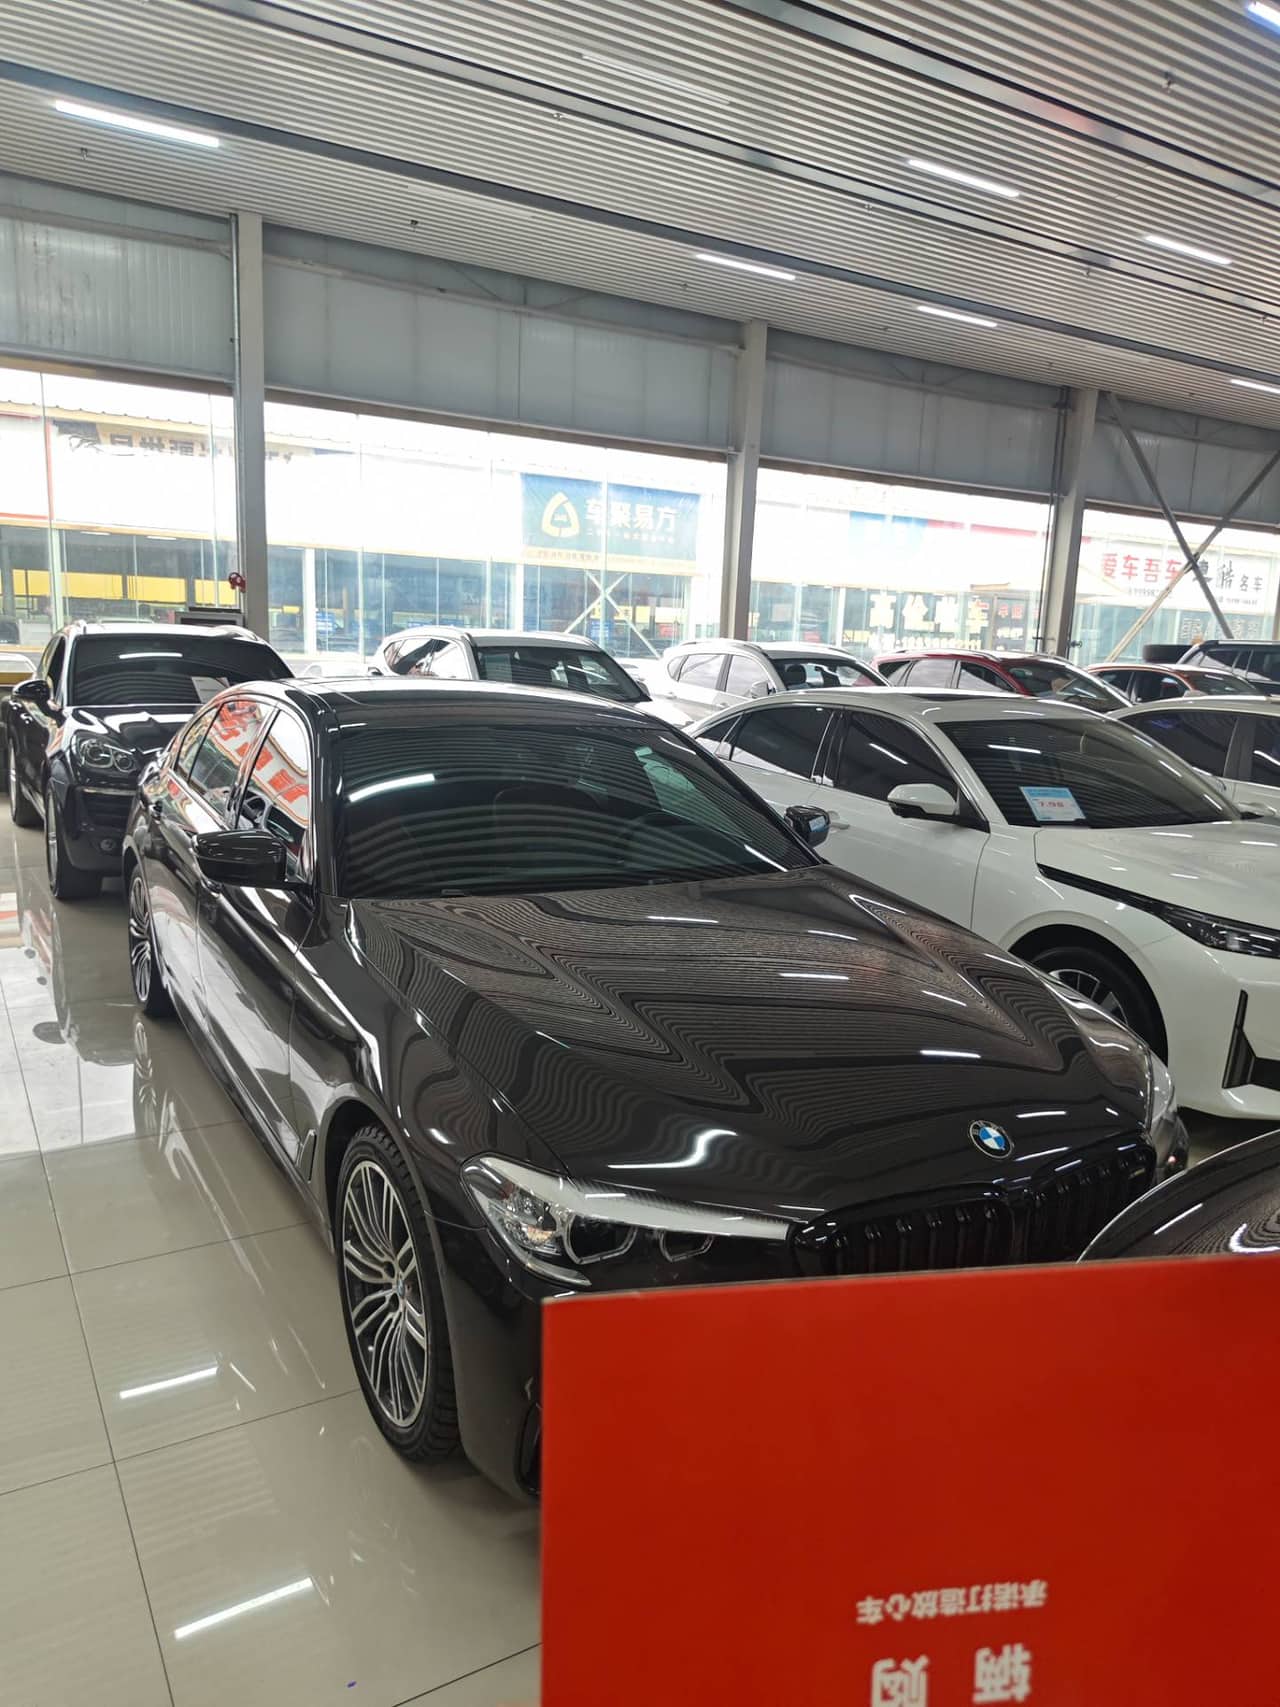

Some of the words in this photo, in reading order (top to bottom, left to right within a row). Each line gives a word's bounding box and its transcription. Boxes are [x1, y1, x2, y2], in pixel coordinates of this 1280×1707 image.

[856, 1579, 1048, 1625] 承诺打造放心车
